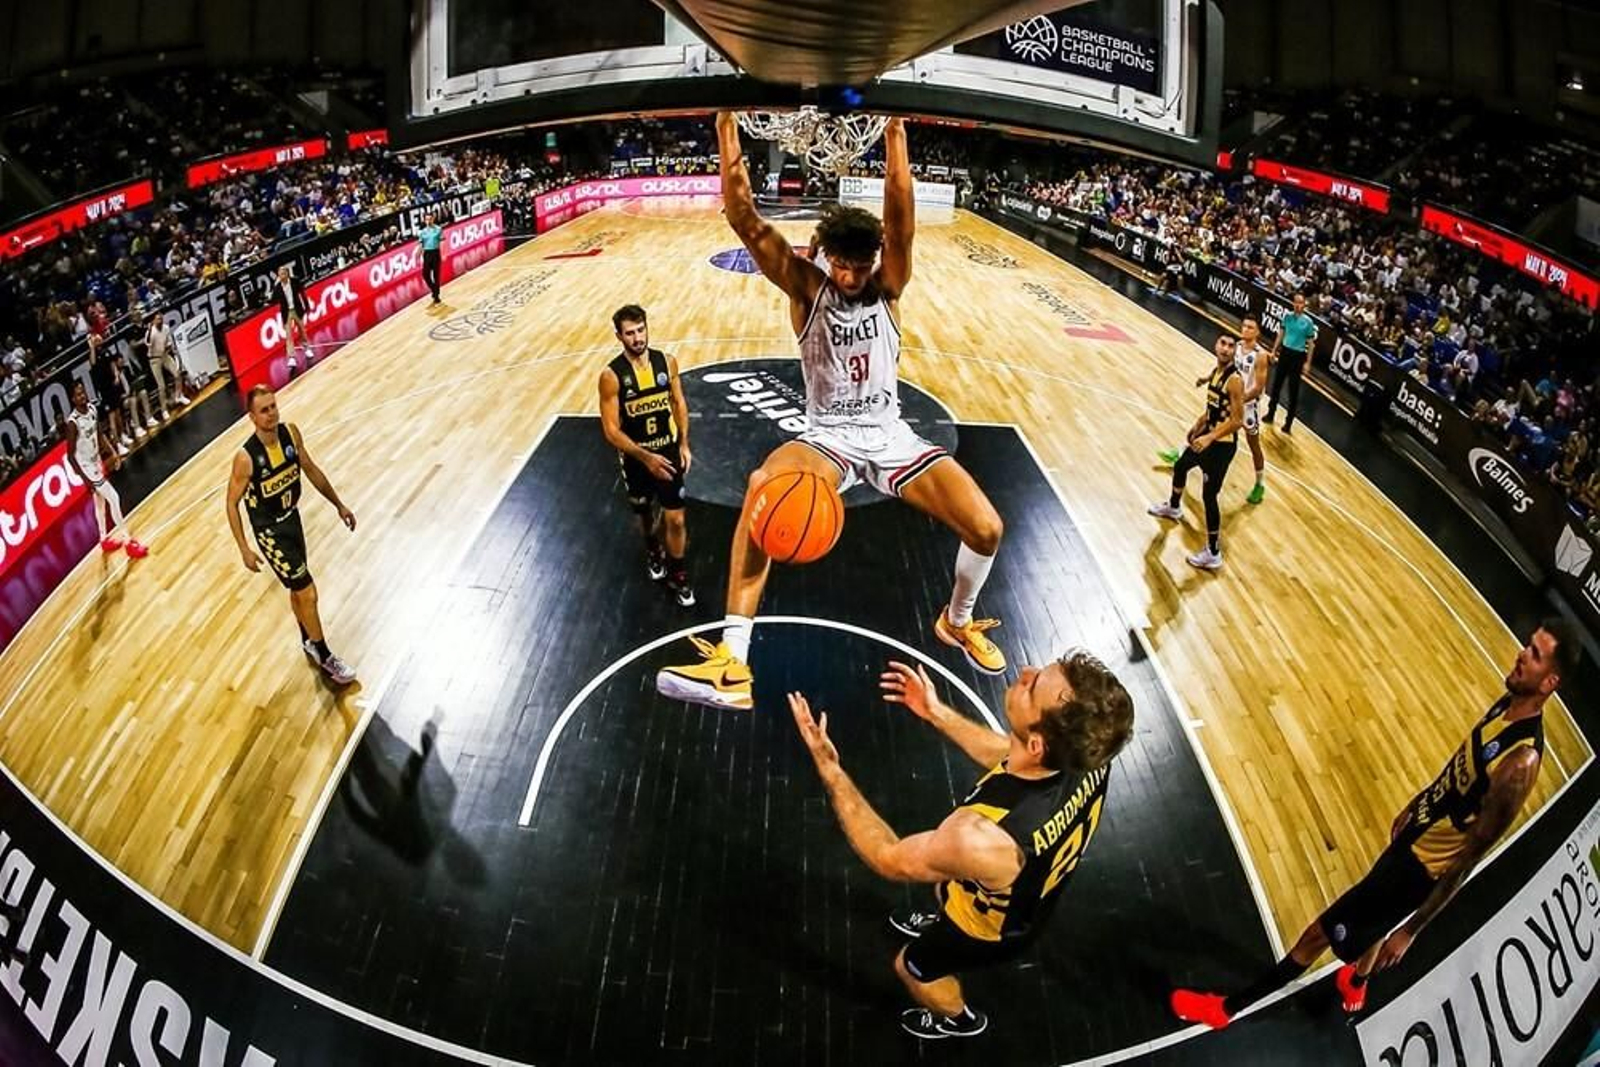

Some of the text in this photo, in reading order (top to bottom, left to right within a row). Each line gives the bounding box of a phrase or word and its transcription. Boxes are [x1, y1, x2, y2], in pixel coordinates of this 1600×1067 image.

[1061, 25, 1145, 57] BASKETBALL
[1061, 37, 1155, 72] CHAMPIONS
[1061, 51, 1114, 73] LEAGUE
[1331, 337, 1372, 382] IOC
[646, 416, 658, 435] 6
